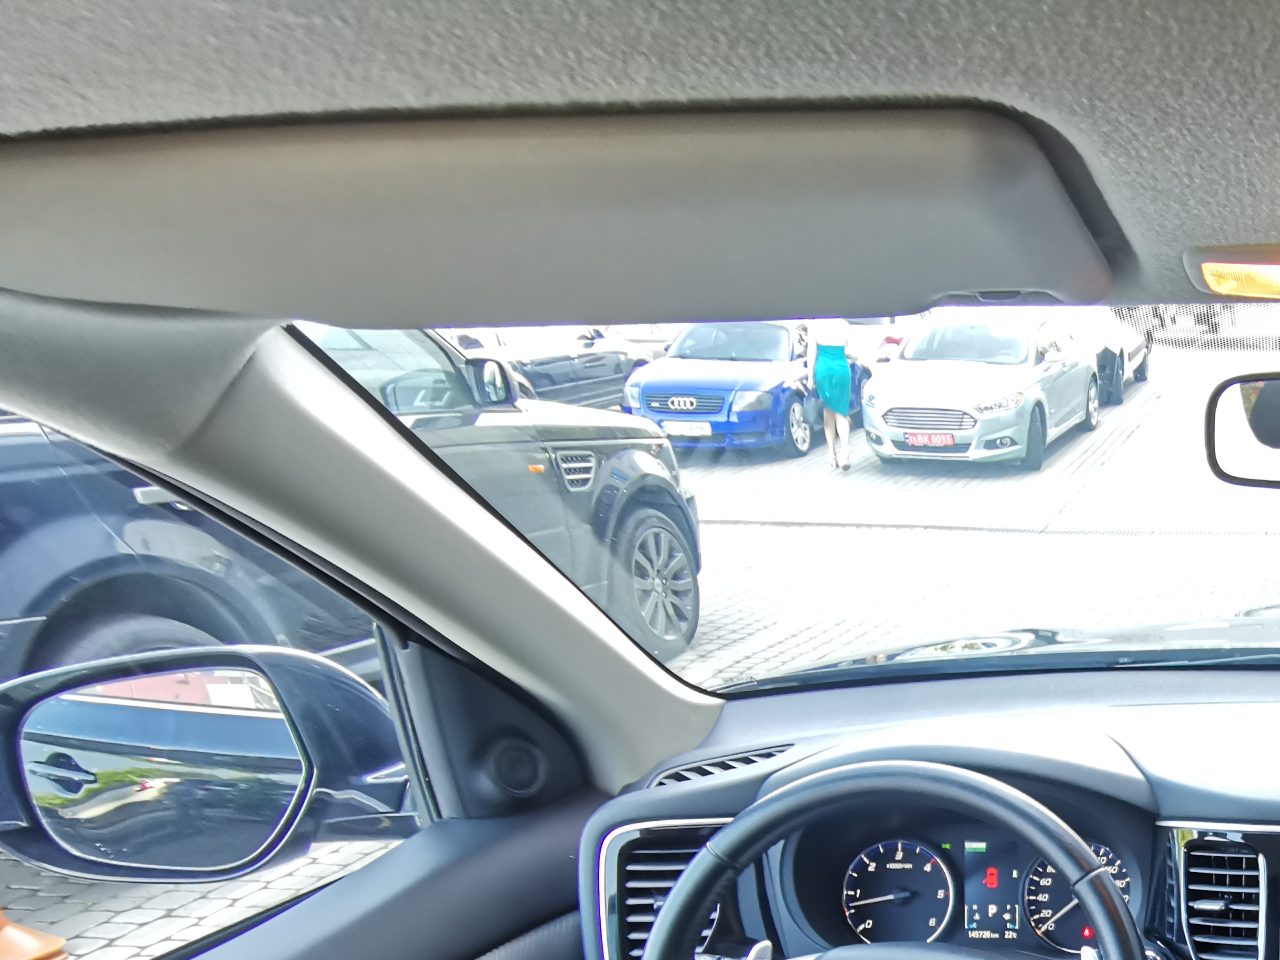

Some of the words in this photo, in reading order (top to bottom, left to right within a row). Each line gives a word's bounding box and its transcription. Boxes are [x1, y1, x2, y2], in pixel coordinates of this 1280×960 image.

[895, 852, 904, 861] 3
[868, 862, 877, 872] 2
[924, 864, 932, 873] 4
[1040, 878, 1052, 886] 60
[856, 889, 861, 899] 1
[937, 889, 946, 899] 5
[1037, 894, 1049, 902] 40
[988, 904, 998, 918] P
[1040, 910, 1052, 918] 20
[865, 920, 873, 929] 0
